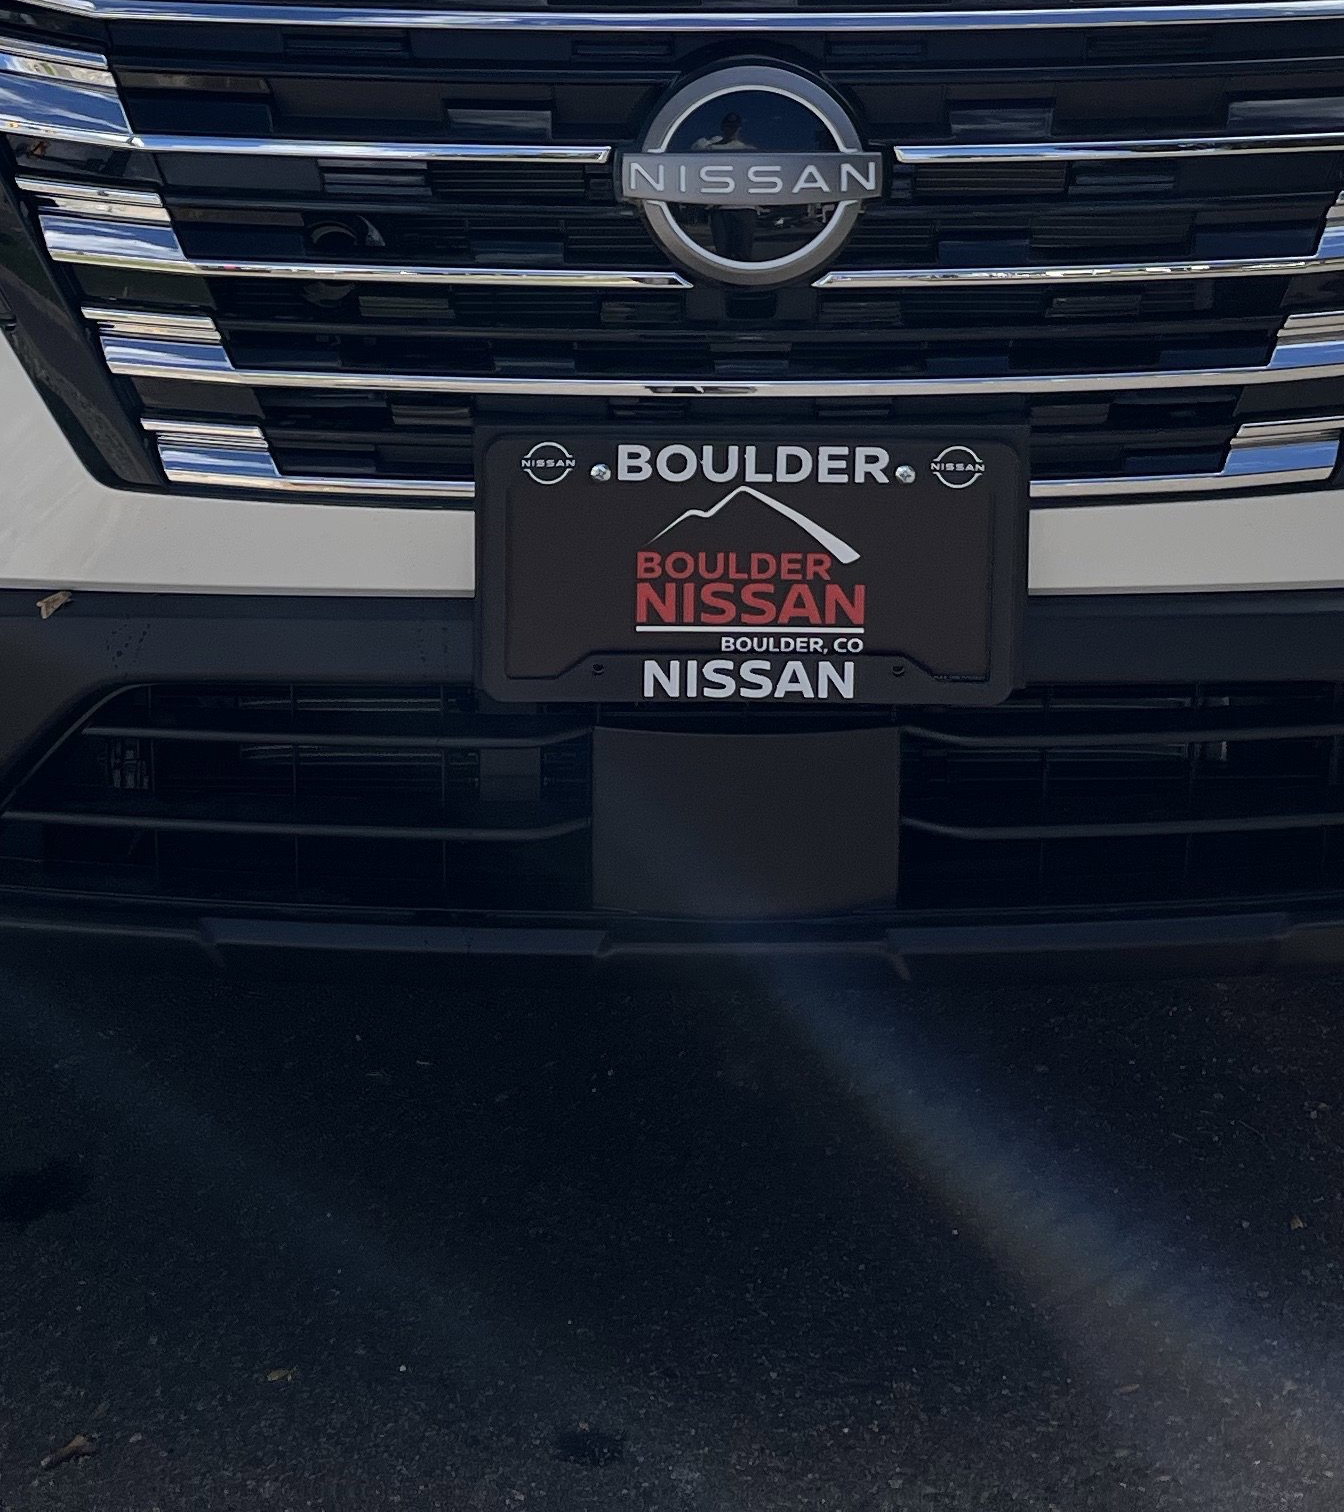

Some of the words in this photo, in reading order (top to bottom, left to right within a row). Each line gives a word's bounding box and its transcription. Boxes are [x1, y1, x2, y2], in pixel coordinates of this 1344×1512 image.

[629, 161, 876, 194] NISSAN
[521, 459, 576, 467] NISSAN
[617, 444, 890, 483] BOULDER
[930, 462, 985, 471] NISSAN
[636, 551, 832, 580] BOULDER
[635, 582, 866, 625] NISSAN
[721, 637, 828, 654] BOULDER,
[833, 638, 864, 653] CO
[643, 660, 855, 699] NISSAN
